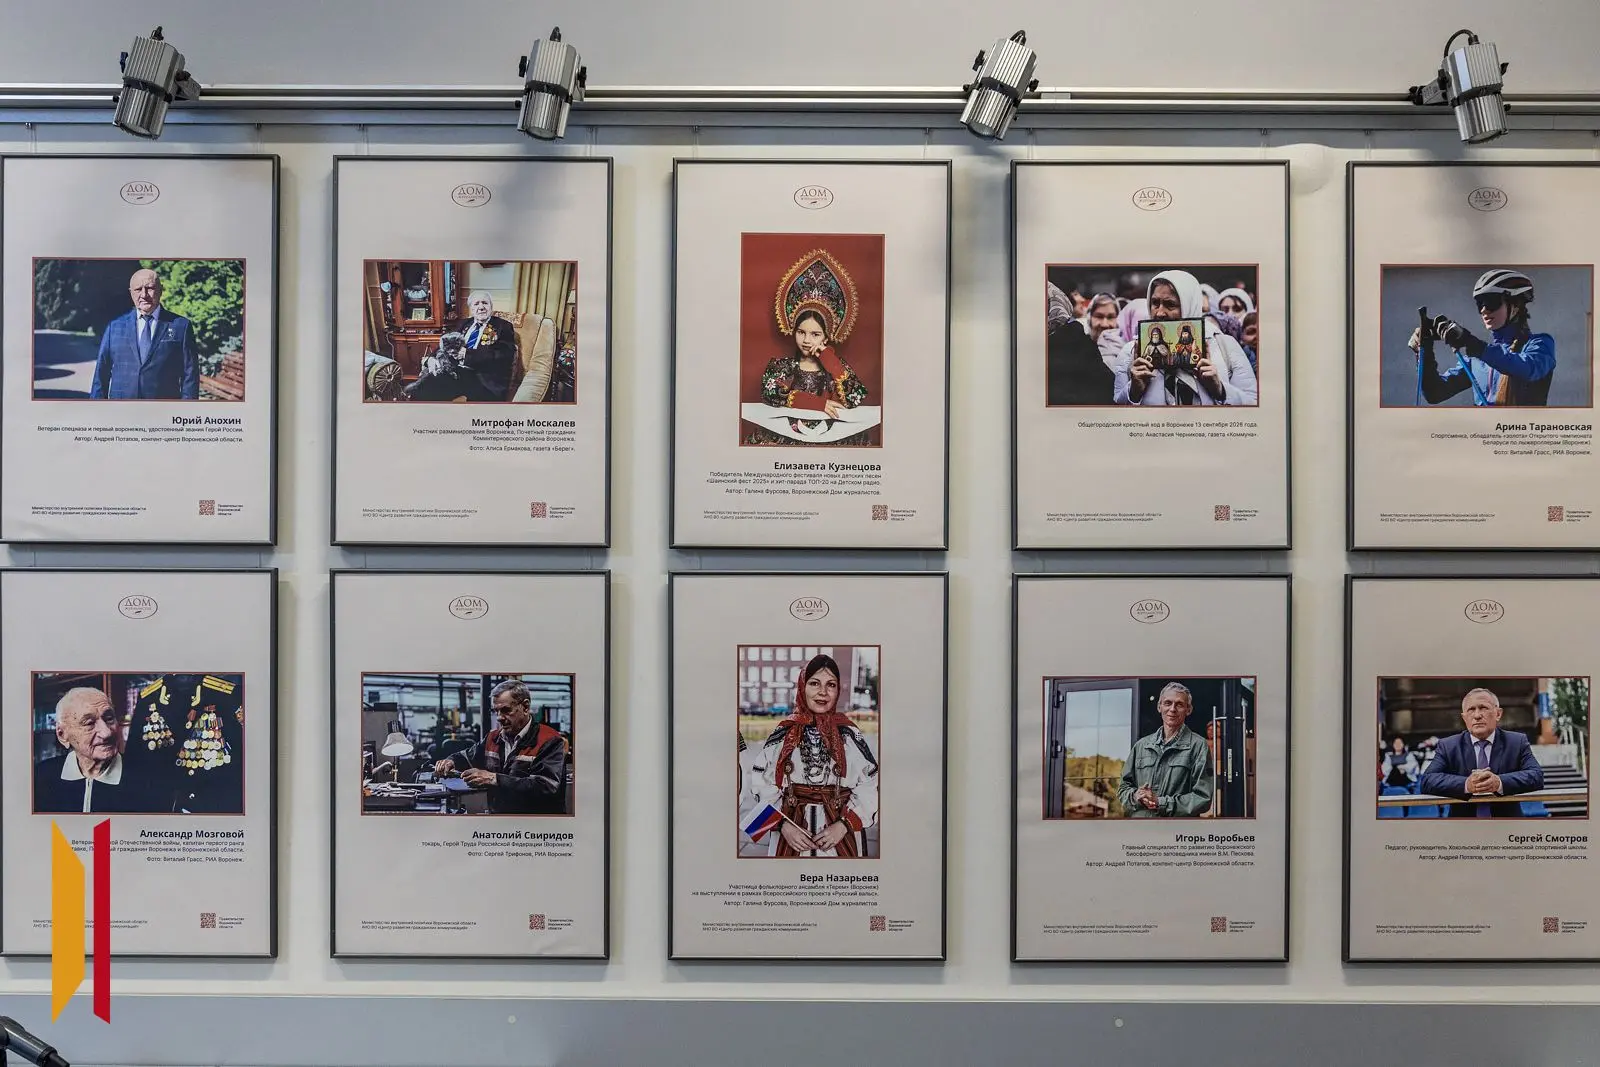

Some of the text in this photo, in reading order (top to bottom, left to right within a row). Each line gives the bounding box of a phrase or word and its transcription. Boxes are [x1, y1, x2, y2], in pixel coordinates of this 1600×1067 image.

[127, 185, 153, 193] ДОМ
[458, 187, 484, 195] ДОМ
[800, 189, 826, 197] ДОМ
[1139, 190, 1166, 198] ДОМ
[1474, 190, 1500, 199] ДОМ
[172, 416, 242, 426] Юрий Анохин
[472, 418, 576, 428] Митрофан Москалев
[1495, 422, 1592, 432] Арина Тарановская
[774, 461, 881, 472] Елизавета Кузнецова
[456, 599, 482, 608] ДОМ
[796, 600, 822, 609] ДОМ
[1136, 603, 1163, 611] ДОМ
[1471, 603, 1498, 611] ДОМ
[140, 829, 244, 840] Александр Мозговой
[472, 830, 574, 841] Анатолий Свиридов
[1175, 833, 1255, 844] Игорь Воробьев
[1508, 834, 1588, 844] Сергей Смотров
[800, 873, 879, 884] Вера Назарьева
